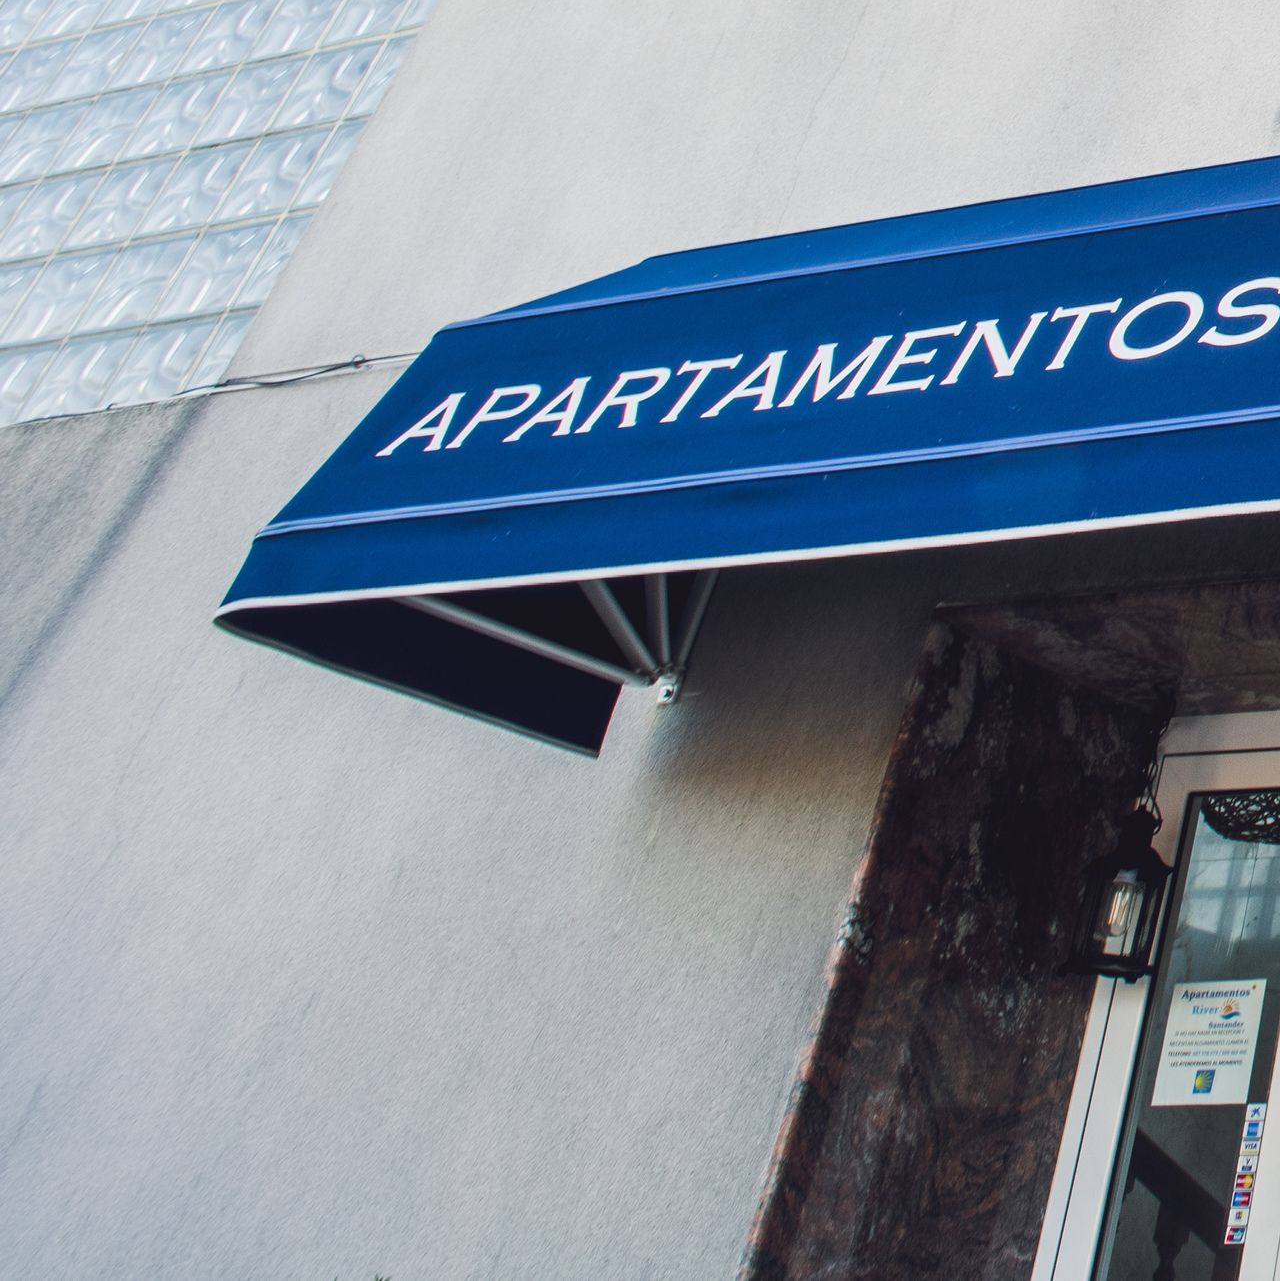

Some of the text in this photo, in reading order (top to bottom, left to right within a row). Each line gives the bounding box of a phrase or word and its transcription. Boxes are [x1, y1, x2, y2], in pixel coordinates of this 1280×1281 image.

[1181, 989, 1251, 1002] Apartamentos
[1192, 1005, 1219, 1015] River
[1208, 1021, 1245, 1030] Santander
[1244, 1142, 1257, 1150] VISA
